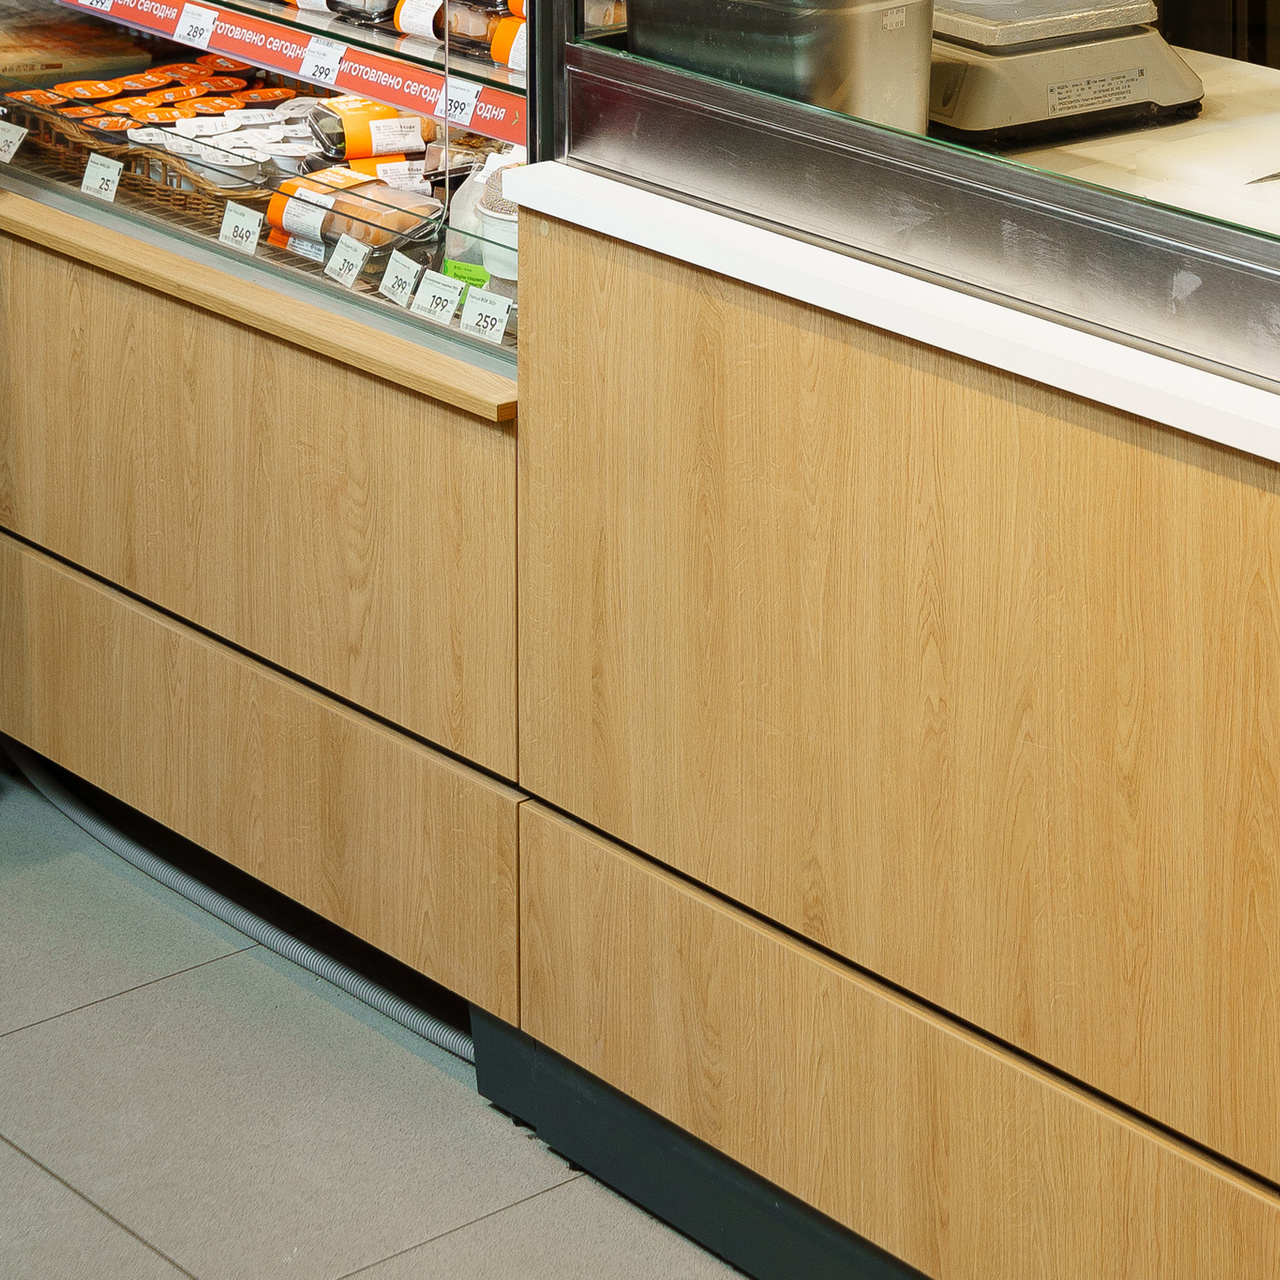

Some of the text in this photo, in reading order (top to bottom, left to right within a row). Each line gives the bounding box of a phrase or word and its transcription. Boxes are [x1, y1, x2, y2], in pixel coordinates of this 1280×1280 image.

[138, 0, 178, 20] сегодня
[186, 24, 204, 39] 289
[312, 65, 331, 79] 299
[447, 99, 466, 115] 399
[98, 177, 110, 191] 25
[231, 225, 251, 243] 849
[338, 258, 355, 275] 319
[391, 275, 408, 294] 299
[429, 294, 449, 312] 199
[475, 312, 498, 332] 259
